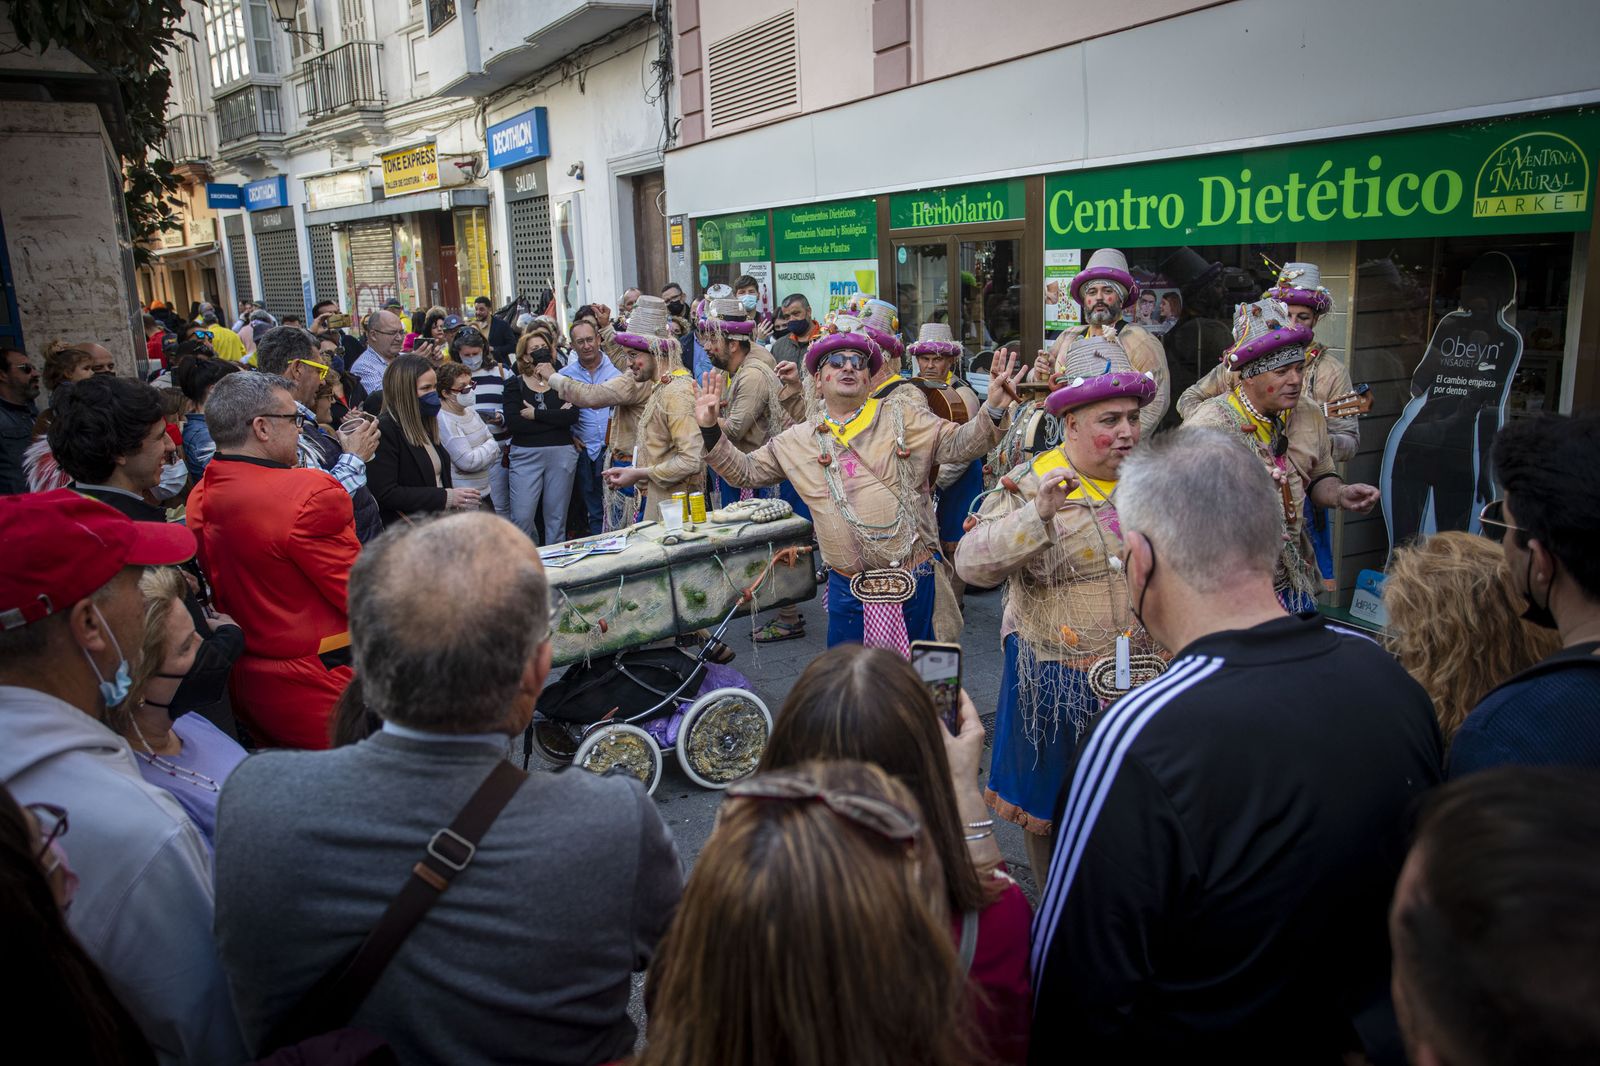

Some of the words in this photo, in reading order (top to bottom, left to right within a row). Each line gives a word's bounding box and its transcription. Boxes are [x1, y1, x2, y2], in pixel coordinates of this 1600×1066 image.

[493, 120, 533, 156] DECATHLON
[383, 156, 401, 174] TOKE
[402, 148, 436, 170] EXPRESS
[515, 172, 537, 193] SALIDA
[248, 183, 276, 202] DECATHLON
[1050, 188, 1185, 234] Centro
[1197, 155, 1463, 227] Dietético
[911, 191, 1004, 226] Herbolario
[1475, 194, 1584, 214] MARKET
[262, 214, 281, 227] ENTRADA
[792, 211, 828, 224] Complementos
[829, 207, 856, 219] Dietéticos
[784, 229, 816, 239] Alimentación
[817, 225, 836, 237] Natural
[841, 223, 867, 237] Biológica
[800, 244, 822, 254] Extractos
[823, 242, 829, 253] de
[830, 242, 850, 253] Plantas
[778, 273, 793, 281] MARCA
[793, 272, 816, 280] EXCLUSIVA
[830, 281, 858, 295] PHYTO
[1441, 336, 1499, 366] Obeyn
[1440, 358, 1475, 368] YNSADIET
[1433, 386, 1446, 394] por
[1446, 386, 1468, 395] dentro
[1436, 375, 1443, 383] El
[1444, 376, 1467, 385] cambio
[1468, 378, 1496, 389] empieza
